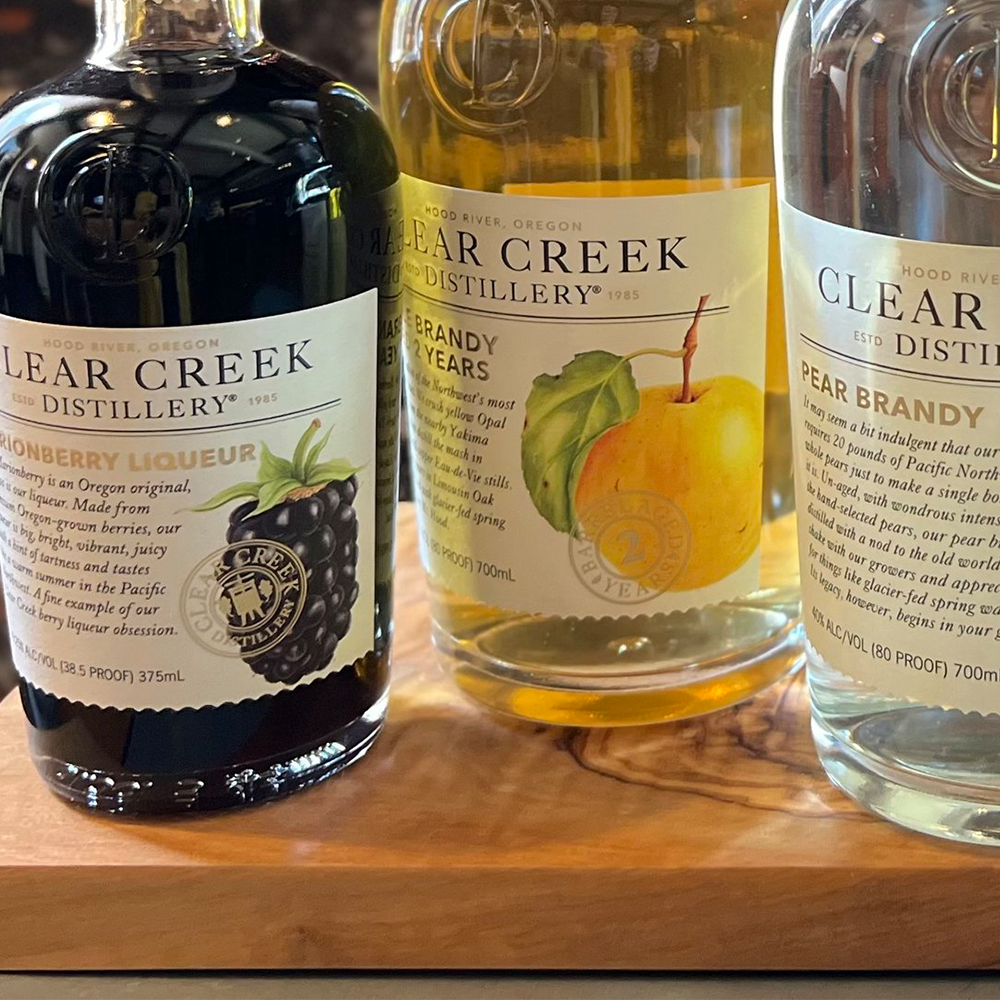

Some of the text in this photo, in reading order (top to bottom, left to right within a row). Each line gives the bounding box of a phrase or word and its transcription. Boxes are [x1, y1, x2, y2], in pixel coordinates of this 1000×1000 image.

[425, 205, 583, 232] HOOD RIVER, OREGON
[402, 217, 484, 267] LEAR
[500, 235, 689, 274] CREEK
[902, 264, 952, 282] HOOD
[607, 289, 640, 301] 1985
[818, 266, 988, 331] CLEAR
[415, 313, 499, 355] BRANDY
[854, 330, 883, 347] ESTD
[43, 338, 219, 353] HOOD RIVER, OREGON
[0, 339, 313, 391] LEAR CREEK
[424, 344, 490, 382] YEARS
[248, 393, 278, 406] 1985
[487, 397, 516, 411] most
[800, 359, 984, 429] PEAR BRANDY
[477, 413, 507, 430] Opal
[810, 403, 825, 422] may
[827, 412, 847, 429] seem
[850, 421, 857, 432] a
[860, 421, 875, 438] bit
[878, 426, 938, 453] indulgent
[941, 439, 970, 455] that
[974, 446, 1000, 458] our
[128, 443, 256, 472] LIQUEUR
[804, 419, 831, 443] requires
[832, 433, 846, 449] 20
[846, 441, 888, 464] pounds
[890, 453, 905, 471] of
[906, 455, 954, 478] Pacific
[78, 477, 192, 499] Oregon original,
[473, 489, 495, 506] Oak
[937, 485, 979, 505] single
[72, 497, 151, 518] Made from
[100, 521, 182, 536] berries, our
[473, 513, 507, 531] spring
[234, 546, 300, 596] CREEK
[477, 560, 516, 582] 700mL
[845, 589, 893, 620] however,
[896, 607, 936, 629] begins
[939, 616, 954, 632] in
[957, 623, 993, 638] your
[113, 623, 178, 637] obsession.
[826, 617, 869, 654] ALC/VOL
[871, 642, 892, 662] (80
[895, 650, 948, 679] PROOF)
[89, 666, 186, 684] PROOF) 375mL
